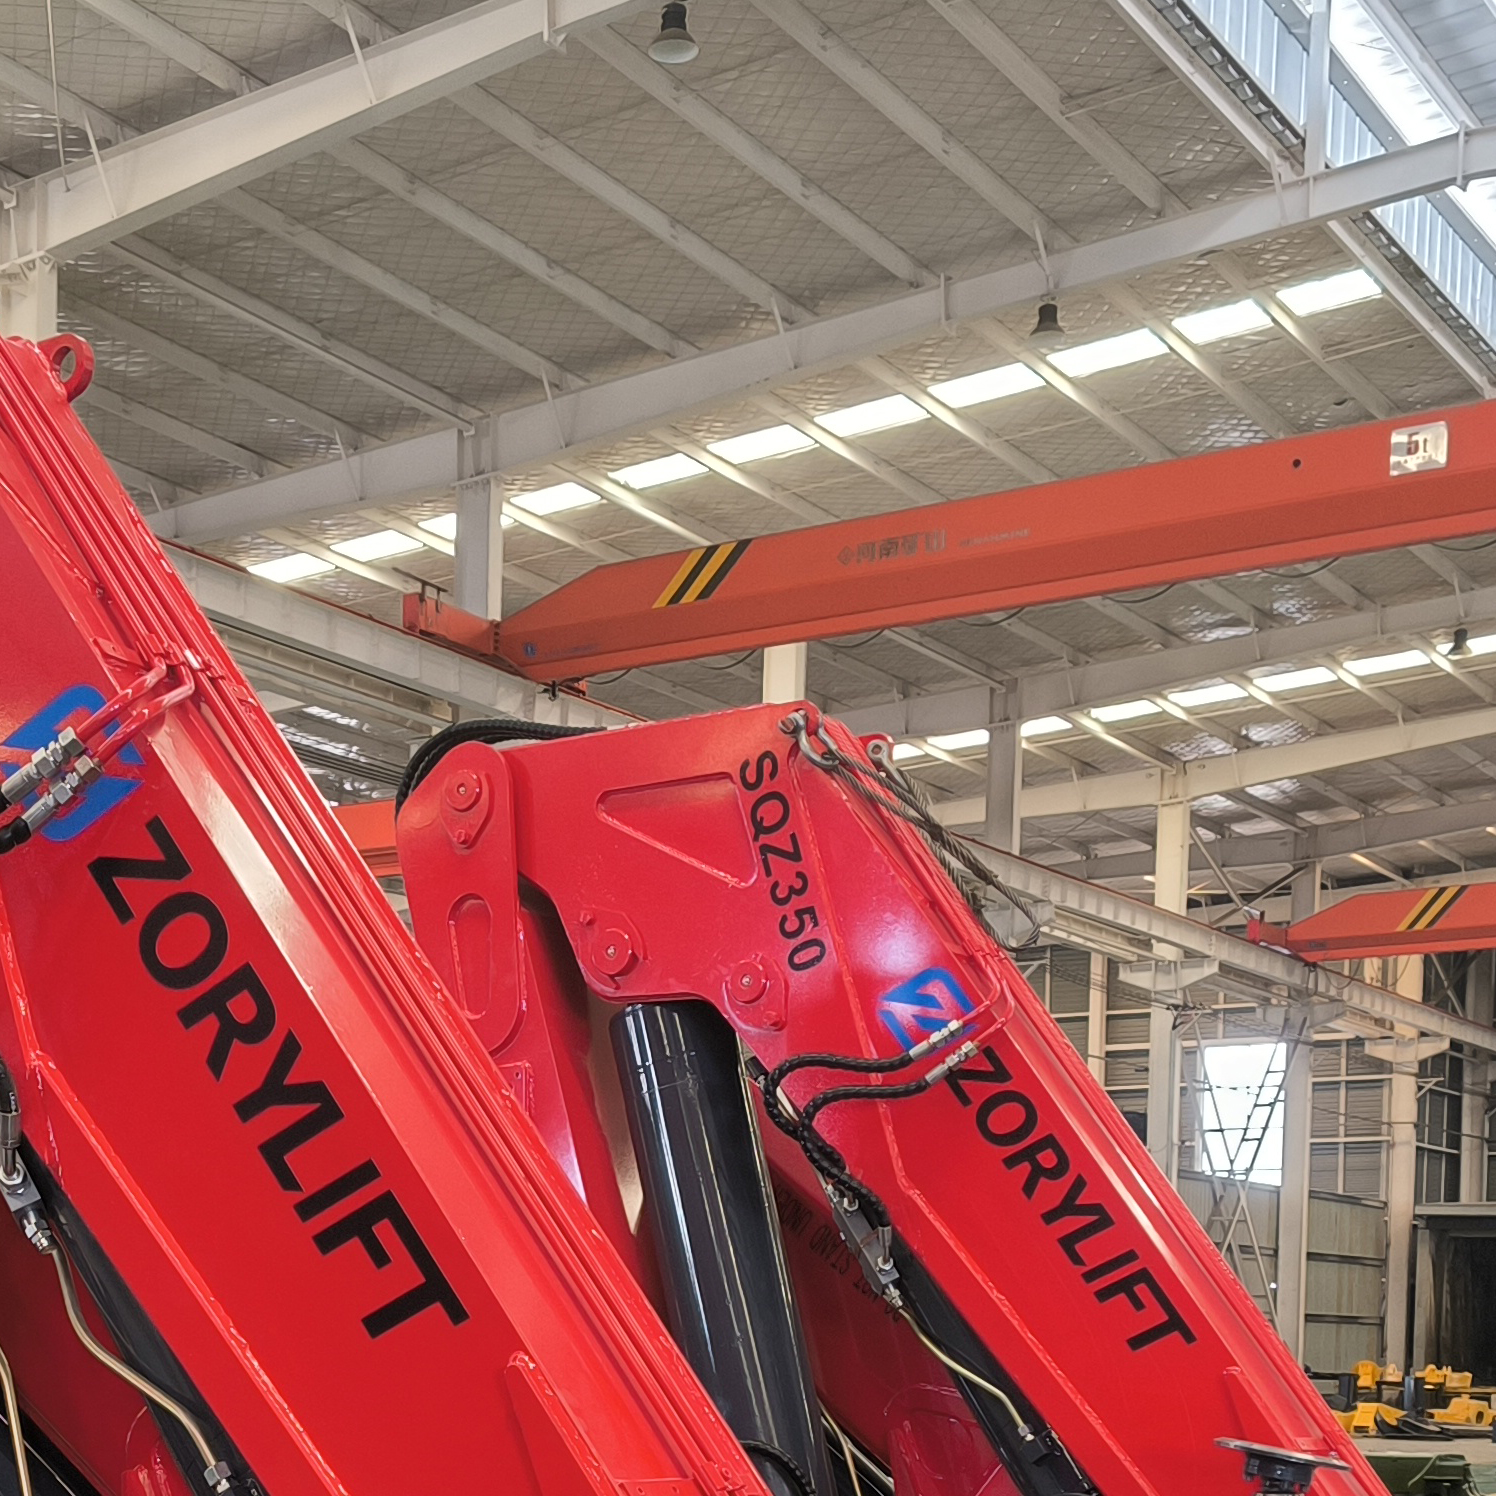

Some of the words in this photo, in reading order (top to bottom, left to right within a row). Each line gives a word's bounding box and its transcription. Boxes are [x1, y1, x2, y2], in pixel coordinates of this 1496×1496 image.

[739, 751, 826, 971] SQZ350
[87, 817, 469, 1339] ZORYLIFT
[940, 1046, 1196, 1351] ZORYLIFT
